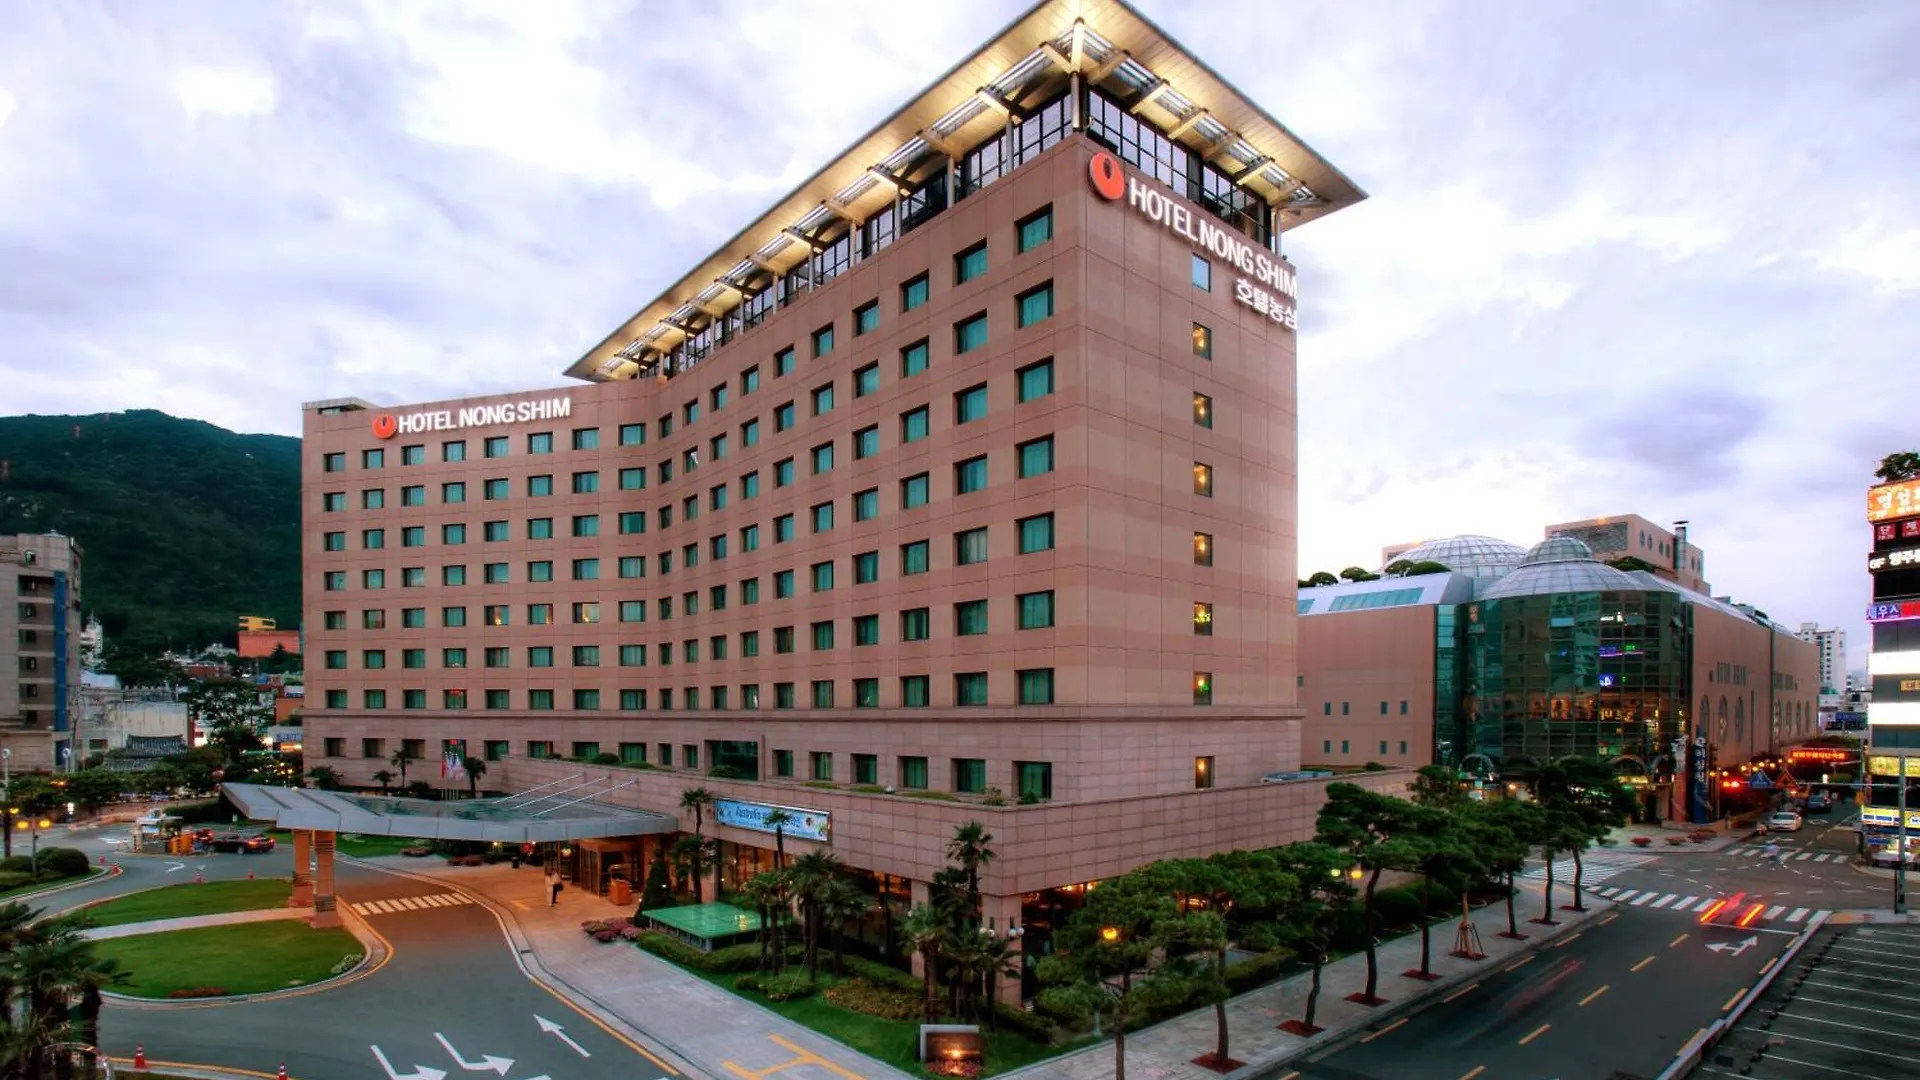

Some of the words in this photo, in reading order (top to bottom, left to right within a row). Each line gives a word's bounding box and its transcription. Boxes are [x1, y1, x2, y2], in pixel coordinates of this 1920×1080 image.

[1128, 178, 1199, 242] HOTEL
[1199, 219, 1254, 276] NONG
[1256, 253, 1297, 299] SHIM
[1235, 277, 1297, 330] 호텔농심
[398, 409, 457, 434] HOTEL
[459, 403, 517, 427] NONG
[517, 397, 571, 422] SHIM
